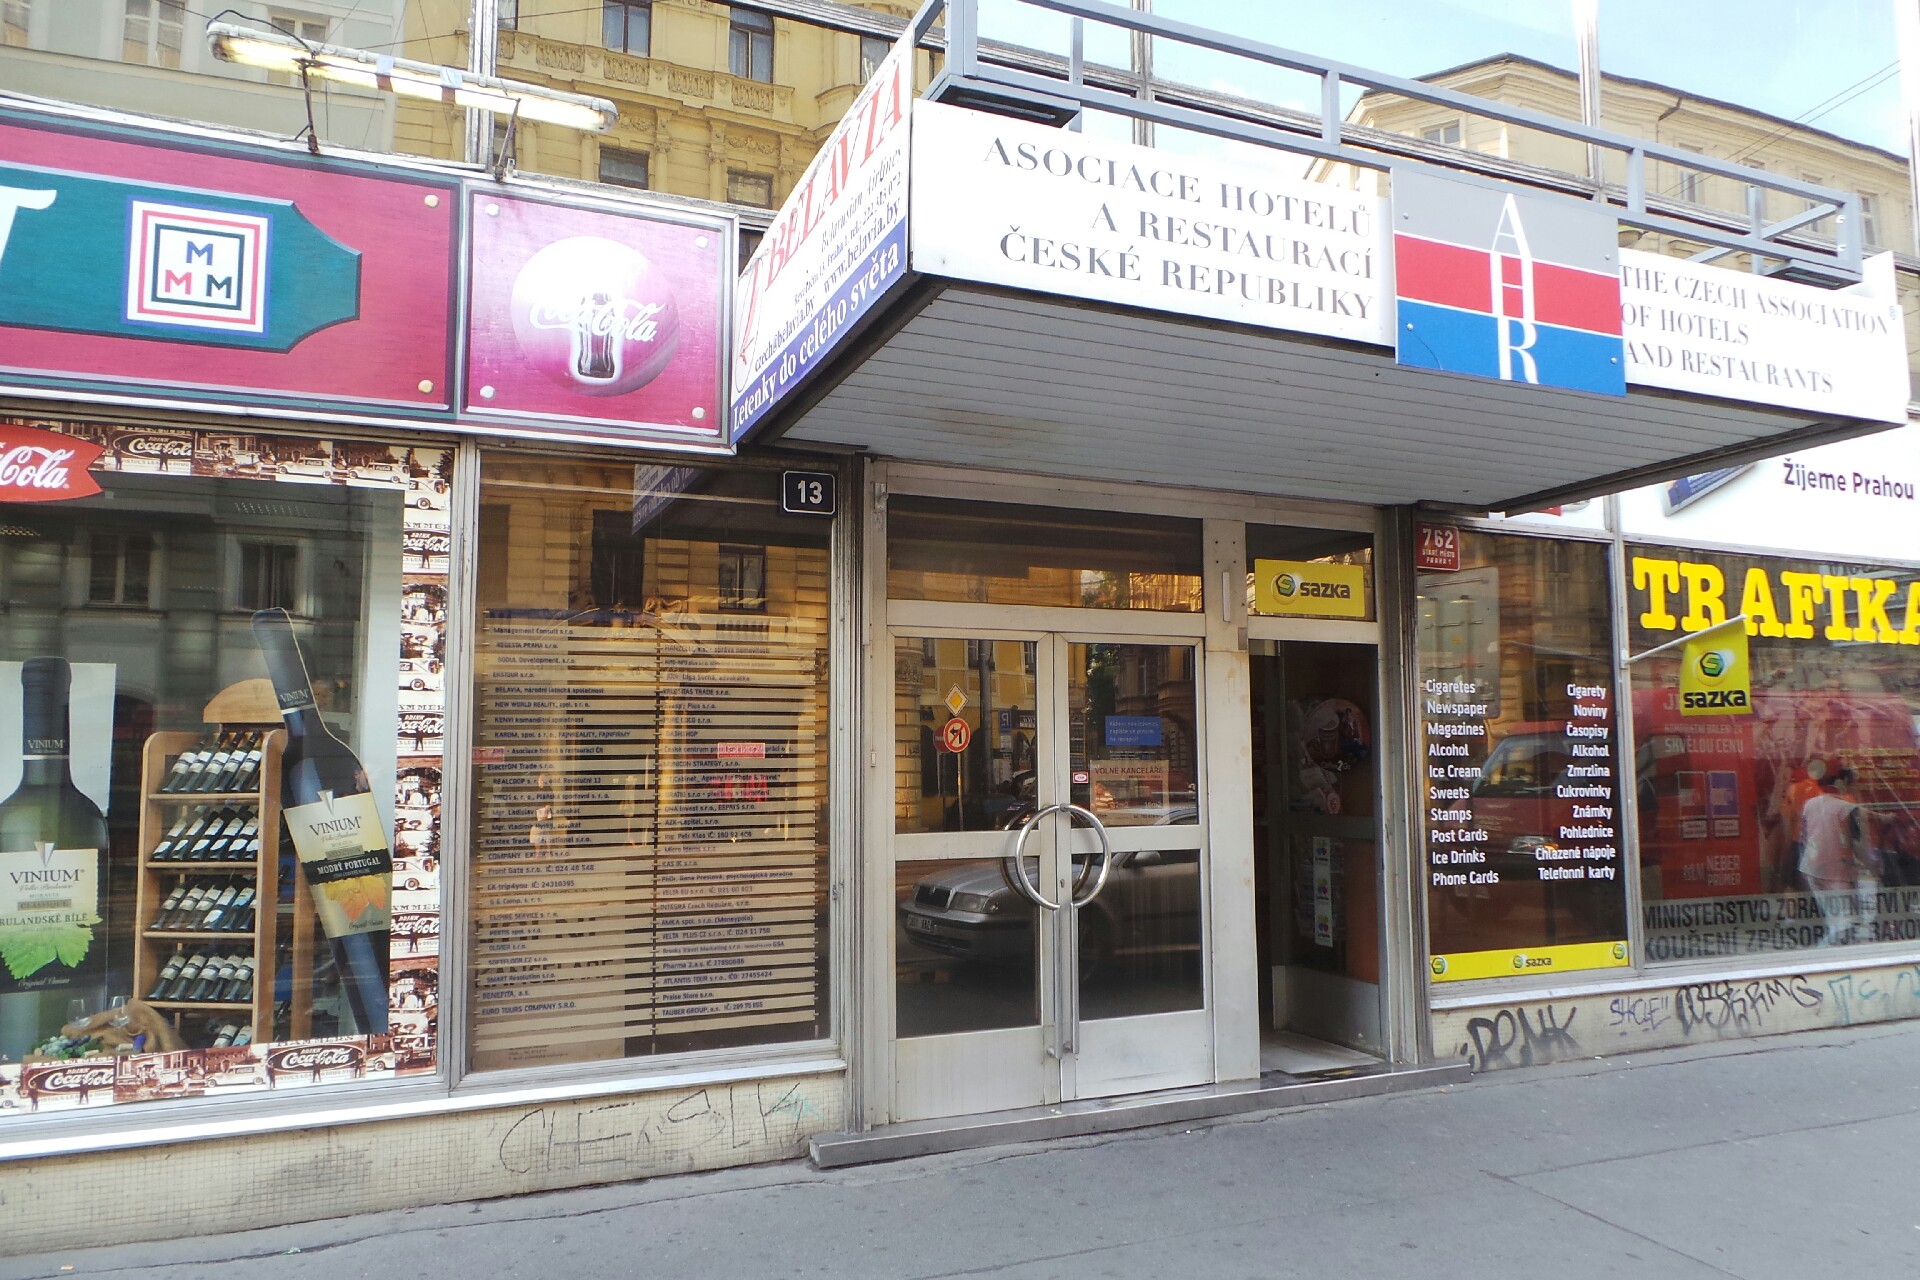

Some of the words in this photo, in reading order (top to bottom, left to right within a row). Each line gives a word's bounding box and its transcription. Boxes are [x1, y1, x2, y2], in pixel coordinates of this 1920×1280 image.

[764, 62, 903, 292] BELAVIA
[983, 137, 1202, 203] ASOCIACE
[1220, 182, 1371, 238] HOTELŮ
[823, 197, 898, 293] www.belavia.by
[1091, 203, 1118, 232] A
[1139, 209, 1374, 279] RESTAURACÍ
[186, 241, 214, 265] M
[1000, 225, 1141, 281] ČESKÉ
[1159, 260, 1374, 319] REPUBLIKY
[165, 269, 191, 295] M
[206, 274, 232, 299] M
[1619, 265, 1668, 295] THE
[1675, 276, 1748, 310] CZECH
[1756, 294, 1890, 336] ASSOCIATION
[530, 297, 667, 342] Coca-Cola
[1621, 307, 1650, 328] OF
[1661, 309, 1749, 346] HOTELS
[733, 370, 777, 432] Letenky
[779, 354, 797, 386] do
[799, 298, 848, 365] celého
[850, 242, 900, 312] světa
[1624, 345, 1673, 369] AND
[1682, 355, 1834, 394] RESTAURANTS
[1783, 458, 1847, 492] Žijeme
[1853, 472, 1914, 500] Prahou
[798, 480, 823, 504] 13
[1422, 527, 1454, 549] 762
[1300, 581, 1350, 599] sazka
[1426, 679, 1475, 695] Cigaretes
[1567, 684, 1606, 699] Cigarety
[279, 688, 310, 703] VINIUM
[1684, 689, 1747, 708] sazka
[1427, 701, 1487, 717] Newspaper
[1574, 704, 1607, 719] Noviny
[1428, 722, 1485, 739] Magazines
[1566, 722, 1608, 739] Časopisy
[27, 739, 64, 750] VINIUM
[1429, 744, 1469, 756] Alcohol
[1572, 744, 1609, 757] Alkohol
[1429, 765, 1445, 778] Ice
[1448, 765, 1482, 778] Cream
[1567, 765, 1610, 777] Zmrzlina
[1430, 787, 1469, 800] Sweets
[1557, 785, 1611, 799] Cukrovinky
[1431, 808, 1472, 823] Stamps
[1573, 806, 1613, 819] Známky
[309, 815, 361, 837] VINIUM
[1560, 826, 1613, 839] Pohlednice
[1432, 830, 1456, 842] Post
[1458, 829, 1488, 842] Cards
[1433, 851, 1449, 864] Ice
[1451, 850, 1486, 864] Drinks
[1535, 848, 1581, 861] Chlazené
[1583, 846, 1616, 860] nápoje
[317, 863, 344, 876] MODRÝ
[343, 858, 381, 871] PORTUGAL
[1538, 866, 1584, 880] Telefonní
[1588, 866, 1615, 880] karty
[9, 869, 80, 884] VINIUM
[1433, 873, 1466, 886] Phone
[1469, 870, 1499, 884] Cards
[65, 913, 88, 922] BÍLÉ
[1525, 957, 1552, 967] sazka
[525, 1003, 555, 1012] COMPANY
[281, 1048, 353, 1069] Coca-Cola
